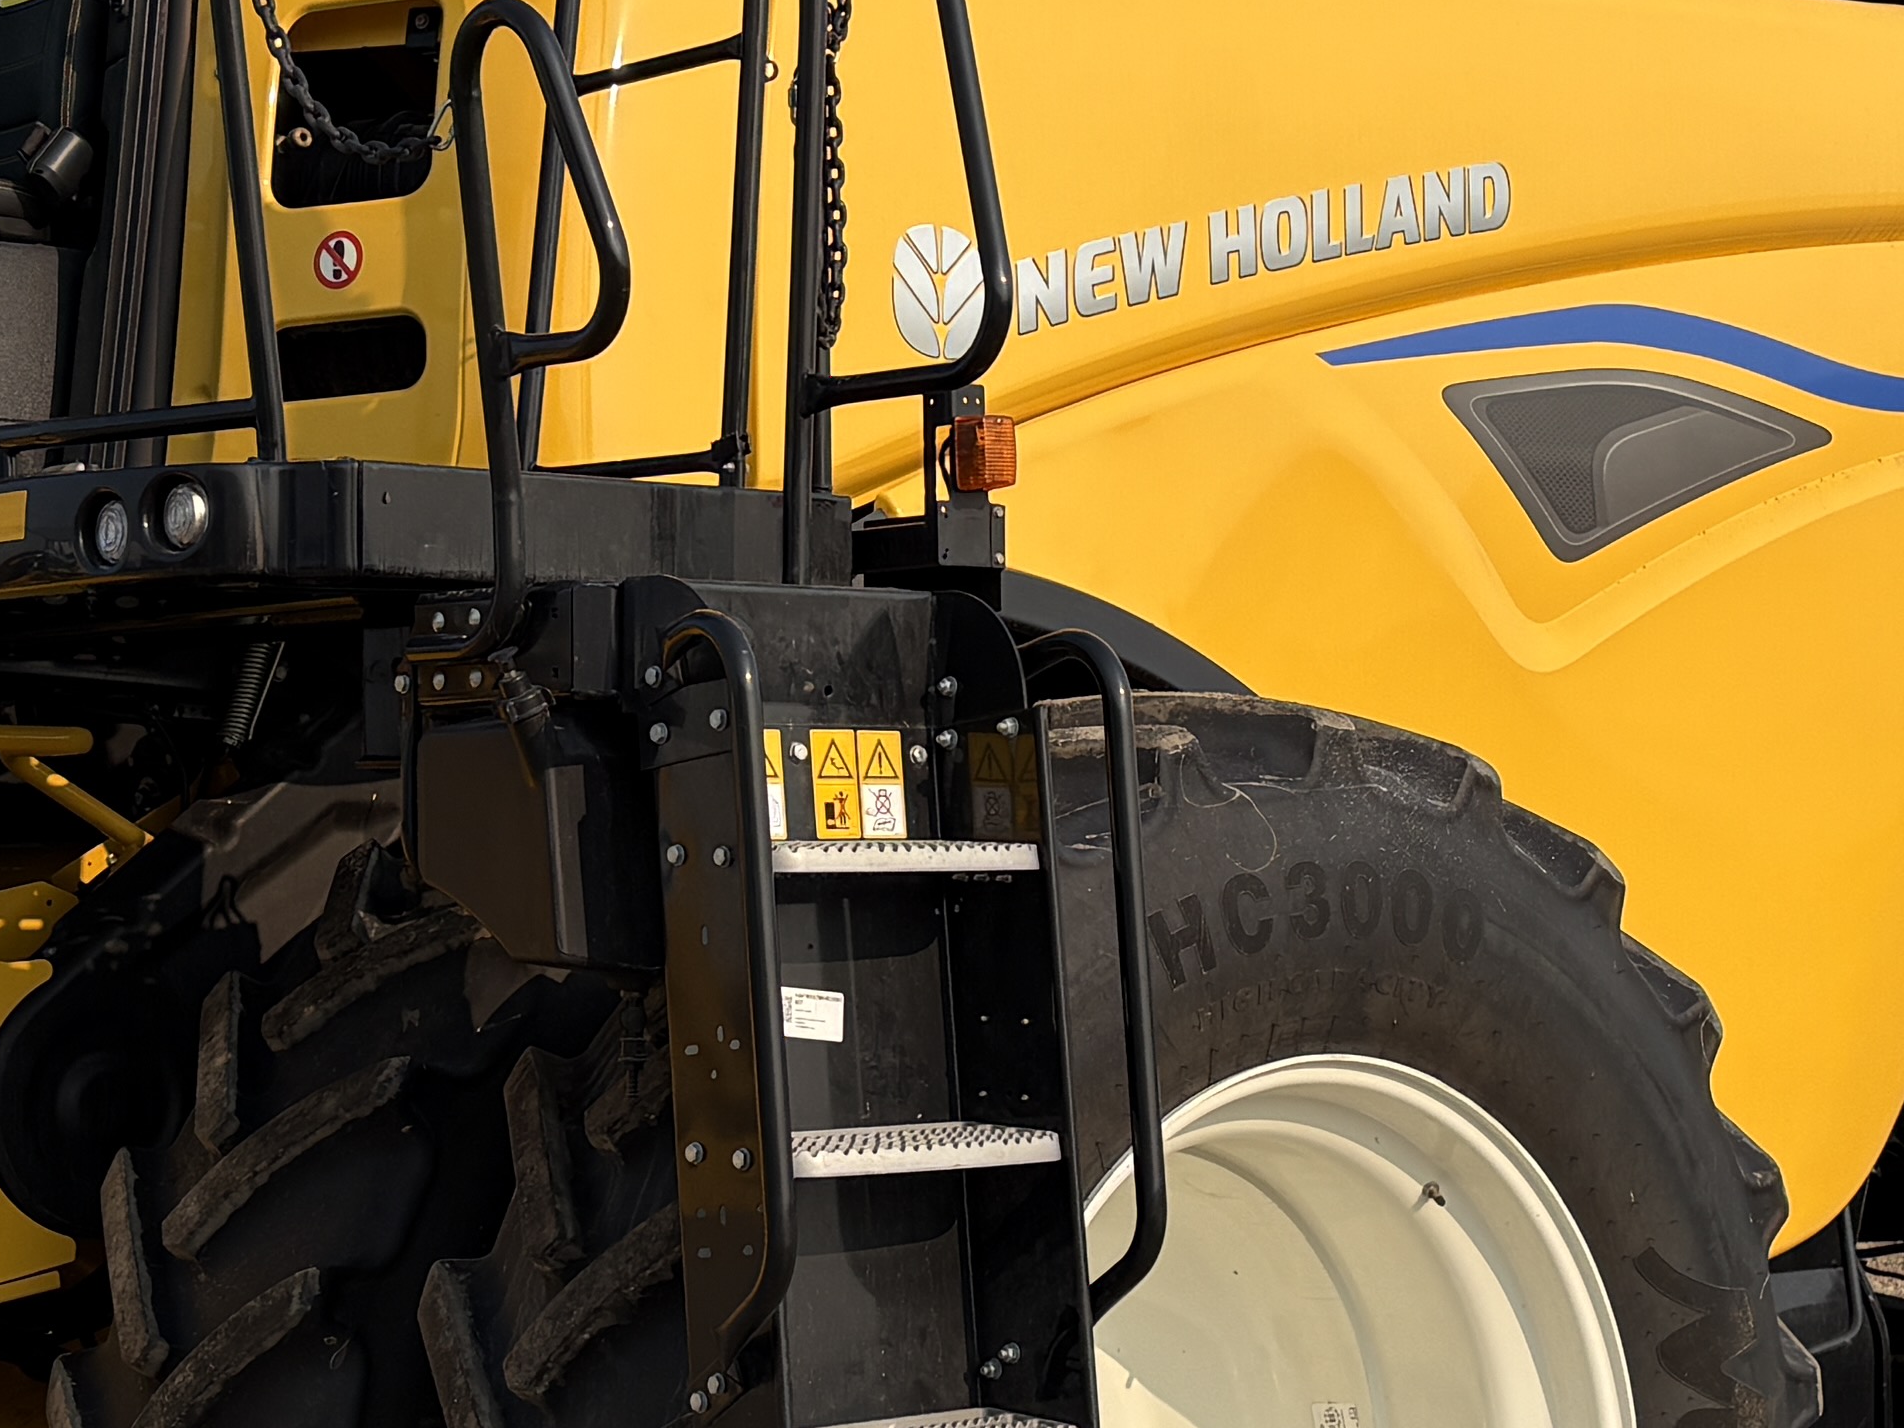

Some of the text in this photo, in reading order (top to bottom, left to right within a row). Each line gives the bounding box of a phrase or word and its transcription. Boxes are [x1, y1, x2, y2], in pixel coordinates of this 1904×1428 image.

[1017, 160, 1512, 336] NEW HOLLAND
[1146, 859, 1488, 992] HC3000
